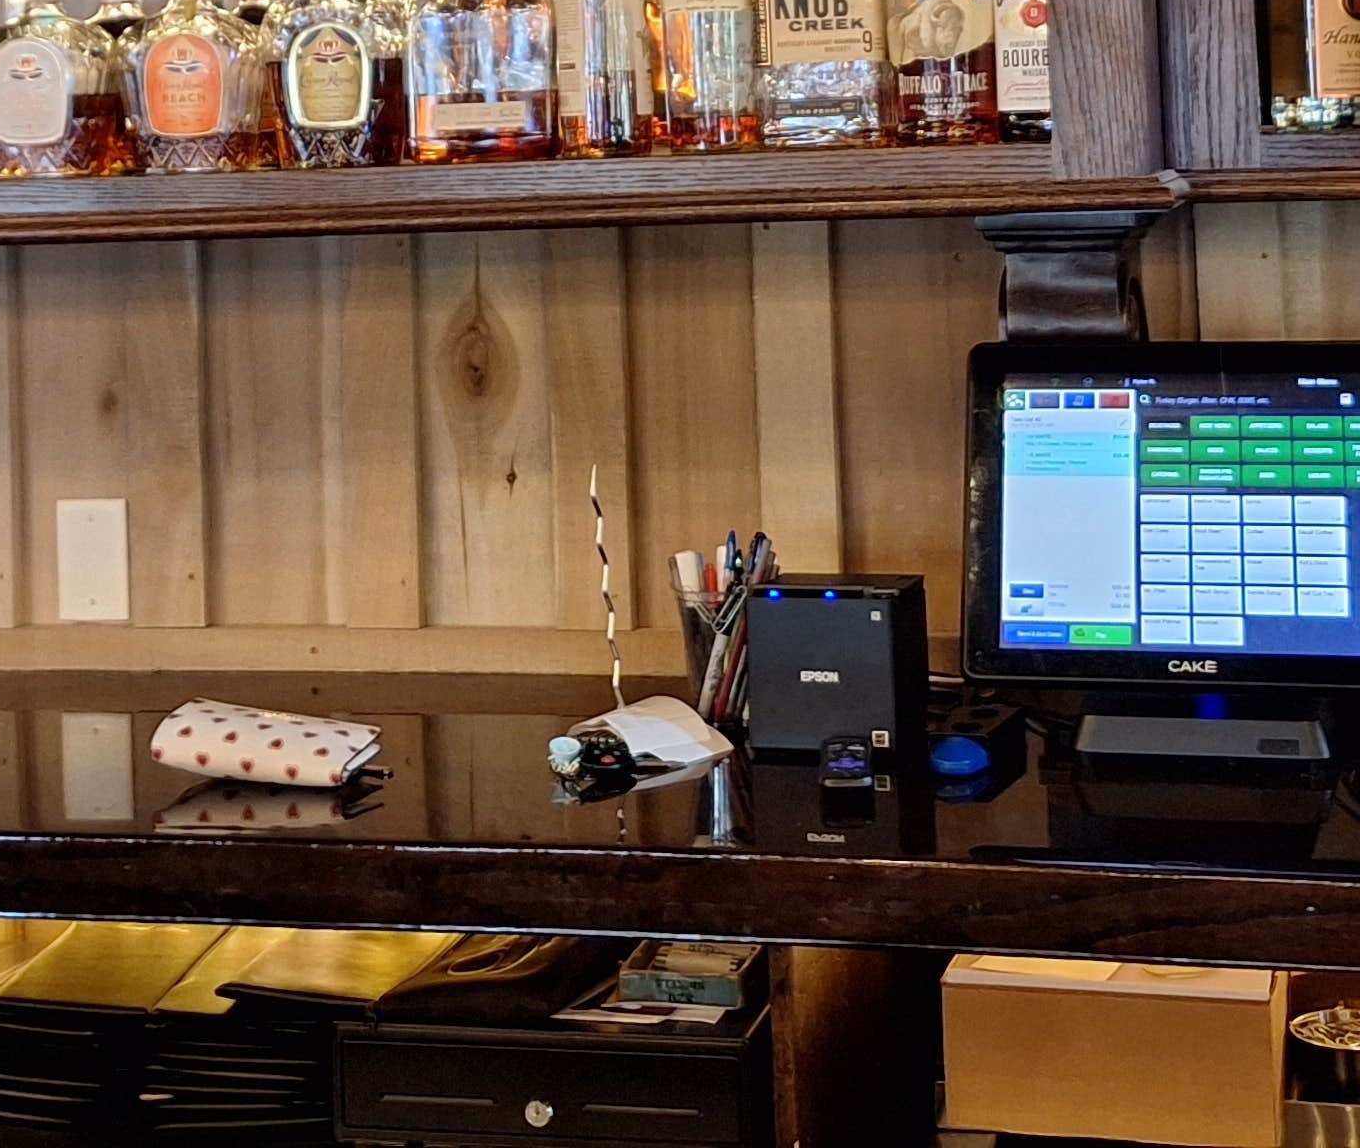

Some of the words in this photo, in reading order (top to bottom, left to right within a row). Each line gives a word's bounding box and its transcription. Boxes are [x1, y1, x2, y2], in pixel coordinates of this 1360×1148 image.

[789, 18, 865, 32] CREEK
[862, 30, 873, 52] 9
[899, 73, 941, 96] BUFFALO
[957, 72, 988, 95] TRACE
[163, 91, 206, 103] PEACH
[1168, 659, 1219, 673] CAKE
[800, 670, 839, 682] EPSON
